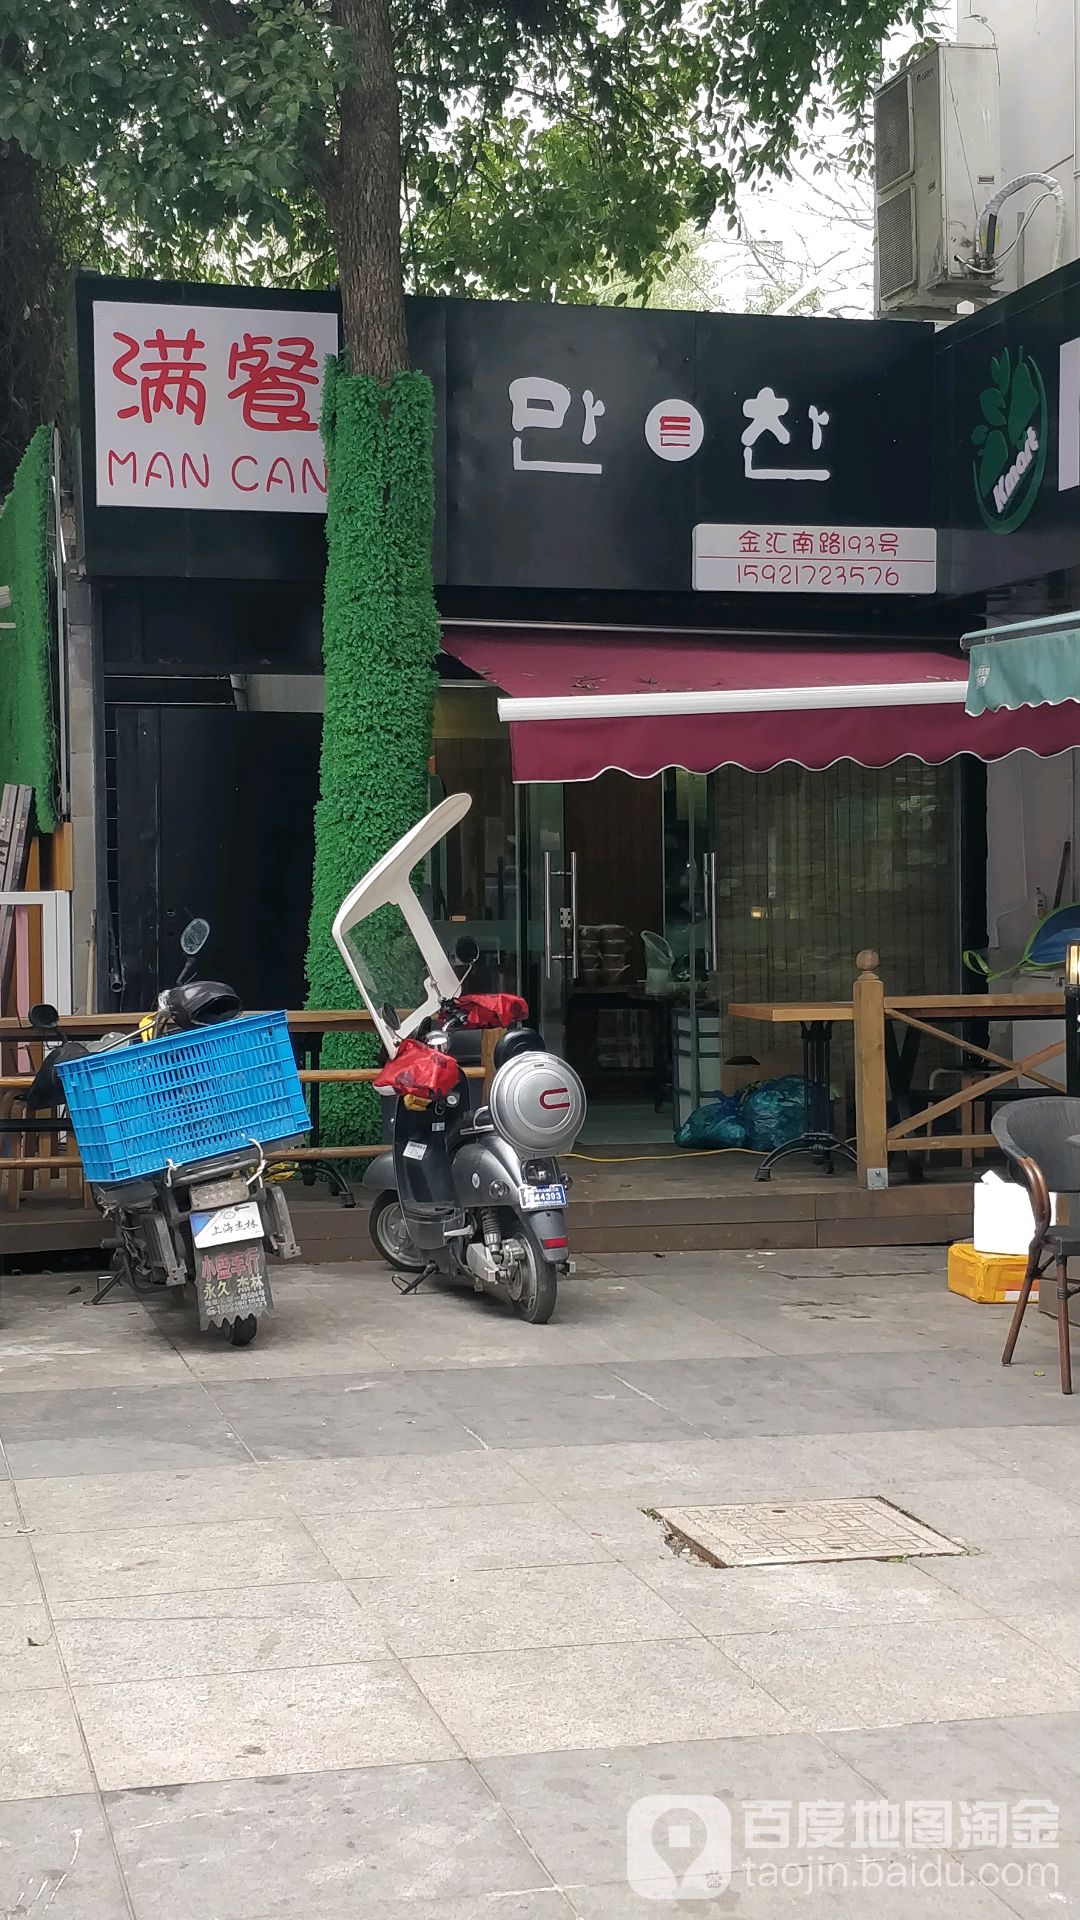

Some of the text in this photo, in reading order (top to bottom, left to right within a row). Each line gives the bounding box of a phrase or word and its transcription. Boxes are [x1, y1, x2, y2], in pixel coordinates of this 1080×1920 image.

[112, 328, 320, 432] 满餐
[107, 449, 329, 494] MAN CAN
[738, 529, 900, 557] 金汇南路193号
[737, 564, 900, 586] 15921723576
[203, 1280, 230, 1300] 永久
